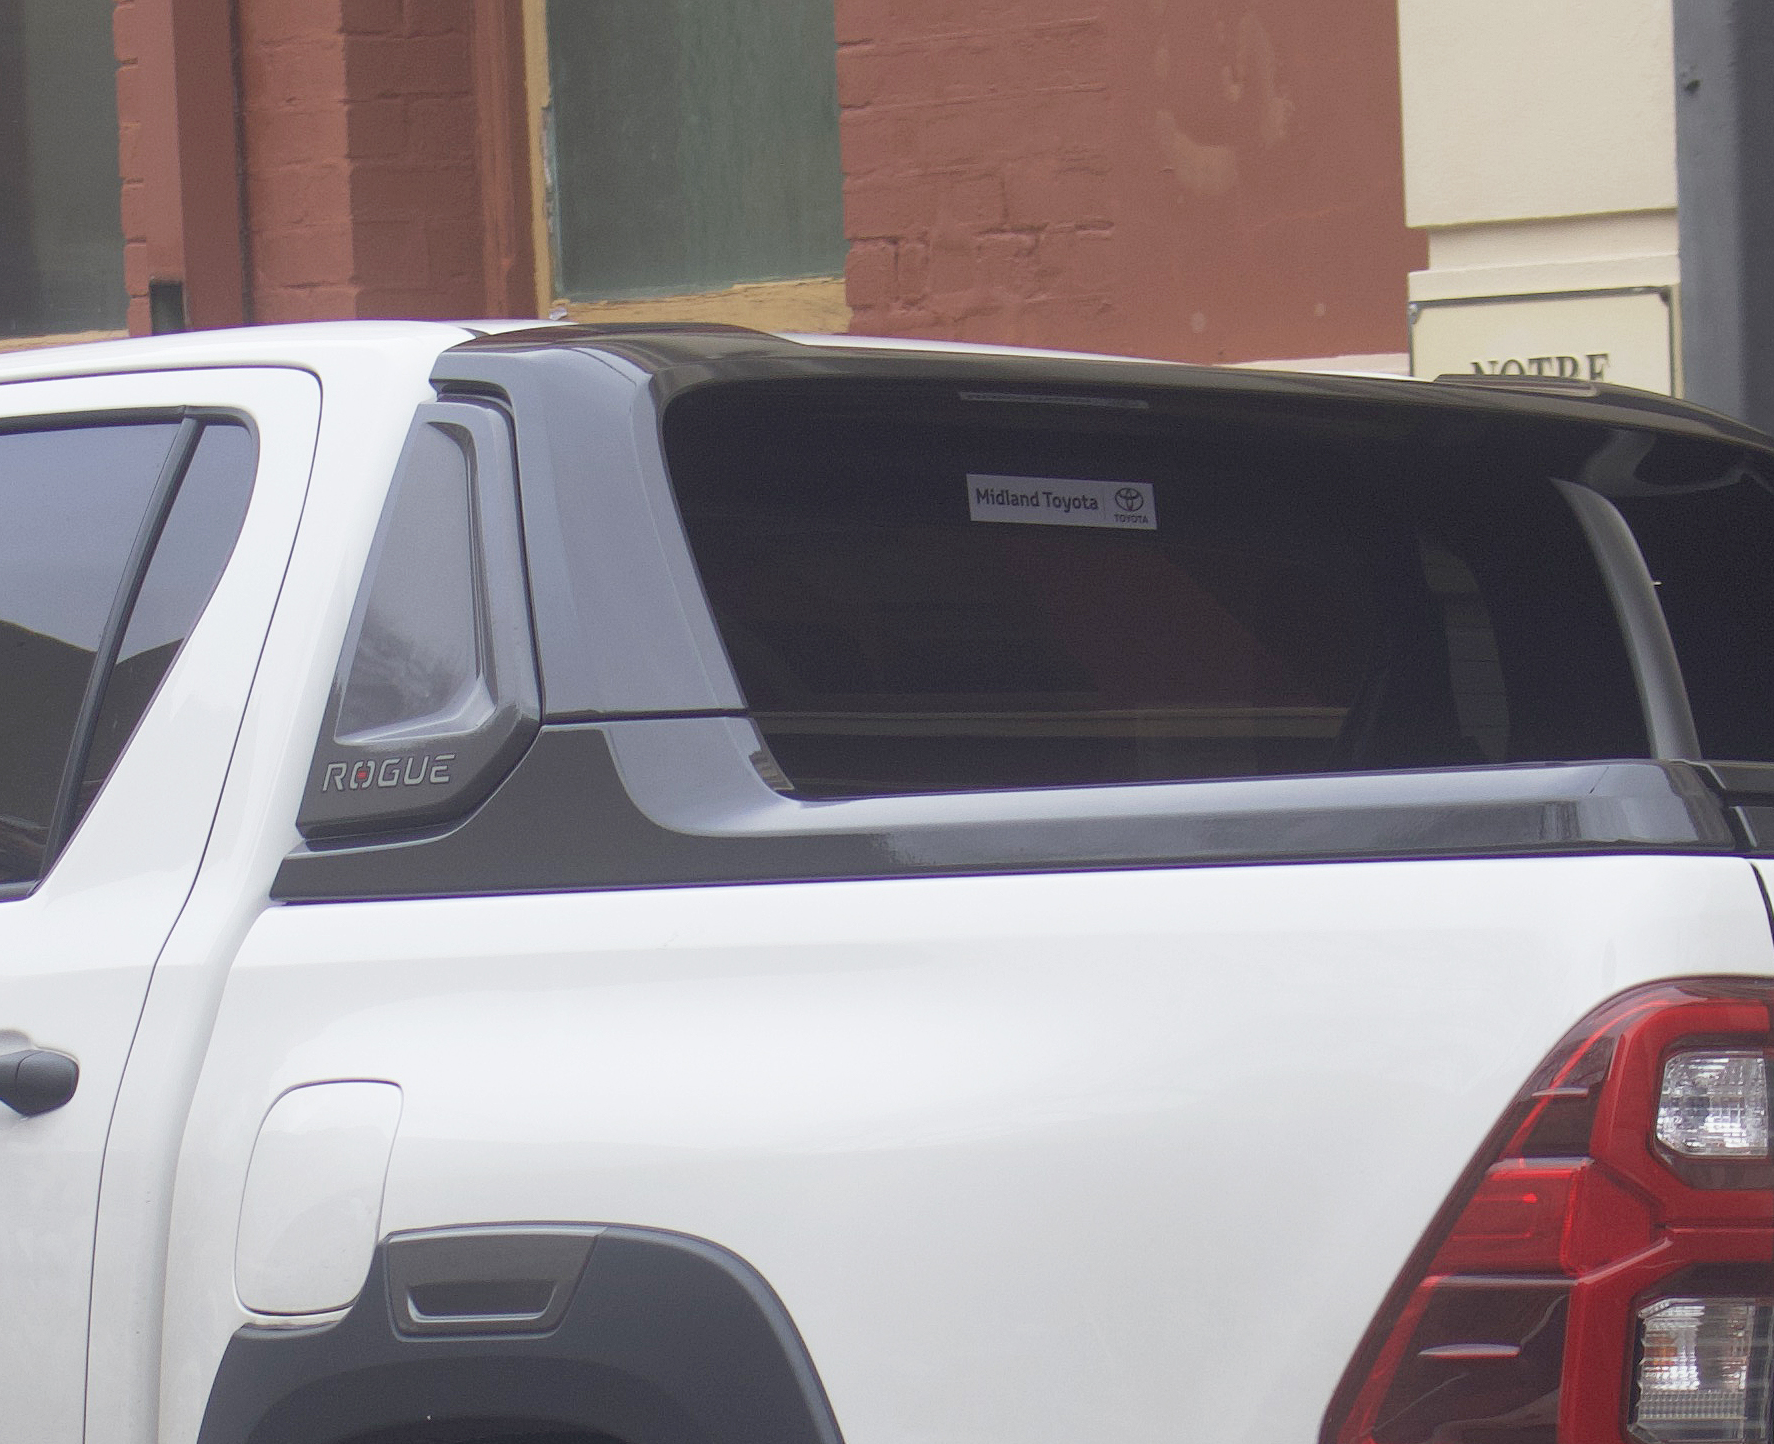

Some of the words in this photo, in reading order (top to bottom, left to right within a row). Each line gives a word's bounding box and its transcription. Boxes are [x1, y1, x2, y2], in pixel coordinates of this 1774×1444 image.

[975, 487, 1040, 508] Midland
[1042, 490, 1099, 513] Toyota
[321, 752, 457, 793] ROGUE
